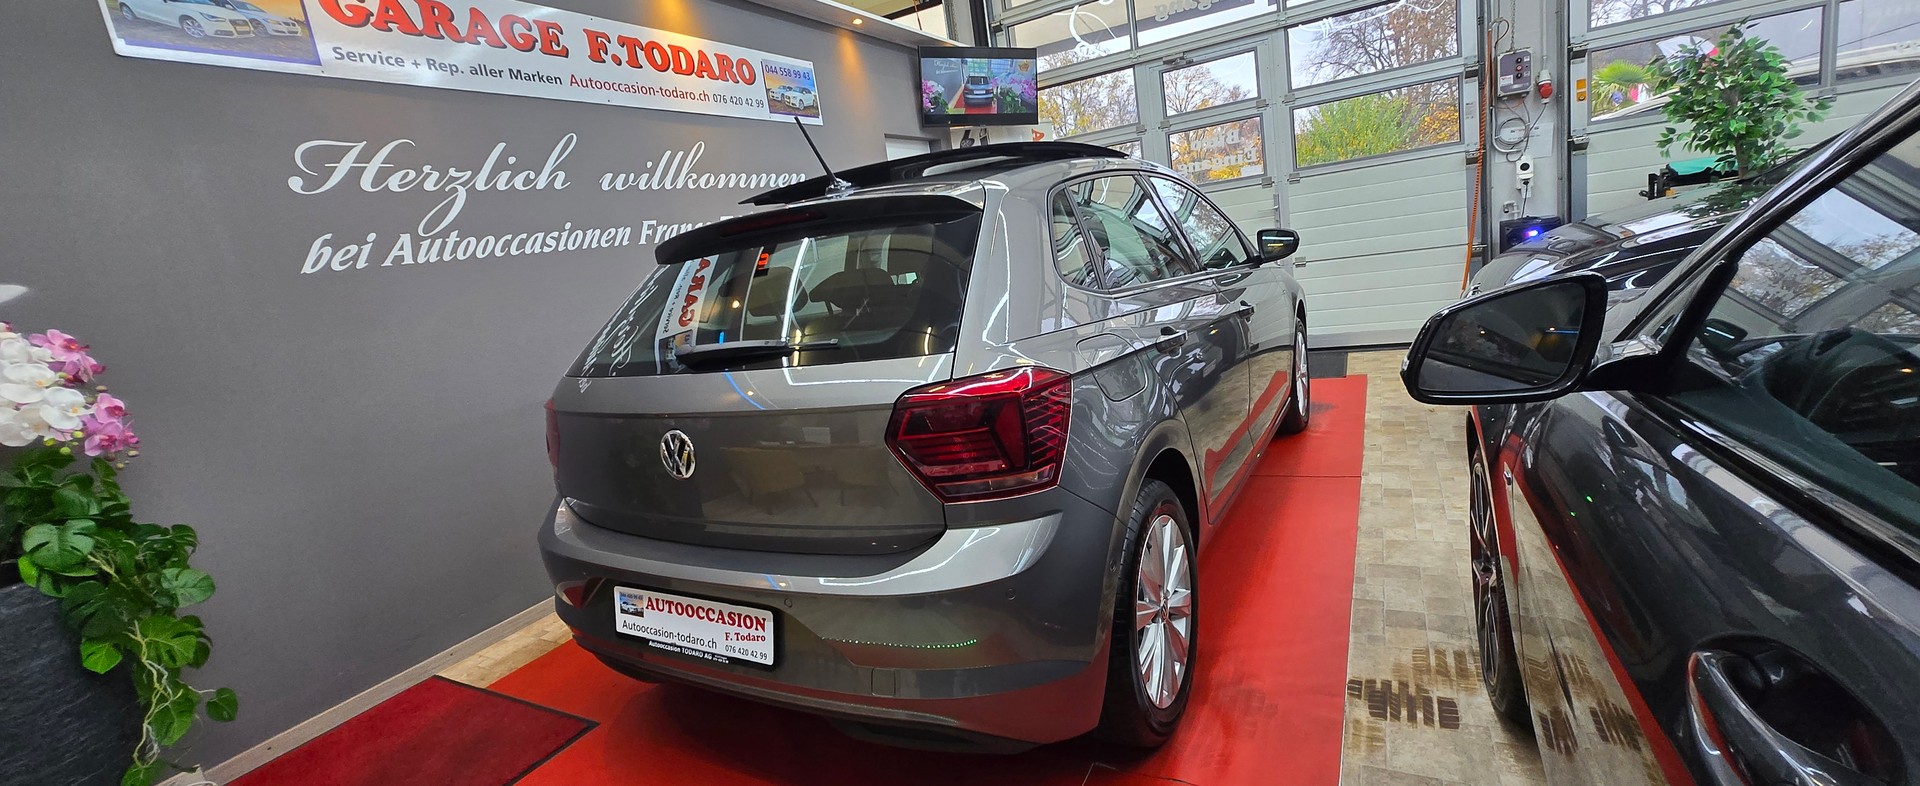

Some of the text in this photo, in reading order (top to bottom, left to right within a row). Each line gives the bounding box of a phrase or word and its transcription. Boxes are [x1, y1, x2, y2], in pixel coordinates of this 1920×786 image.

[318, 0, 569, 58] GARAGE
[332, 46, 765, 109] Service + Rep. aller Marken Autooccasion-todaro.ch 076 420 42 99
[765, 64, 778, 75] 044
[779, 67, 792, 77] 558
[803, 71, 811, 80] 43
[287, 132, 806, 237] Herzlich willkommen
[300, 232, 377, 274] bei
[381, 222, 632, 267] Autooccasionen
[645, 597, 767, 632] AUTOOCCASION
[622, 619, 717, 649] Autooccasion-todaro.ch
[648, 640, 681, 653] Autooccasion
[681, 647, 704, 658] TODARO
[724, 632, 766, 642] F. Todaro
[724, 644, 768, 661] 076 420 42 99
